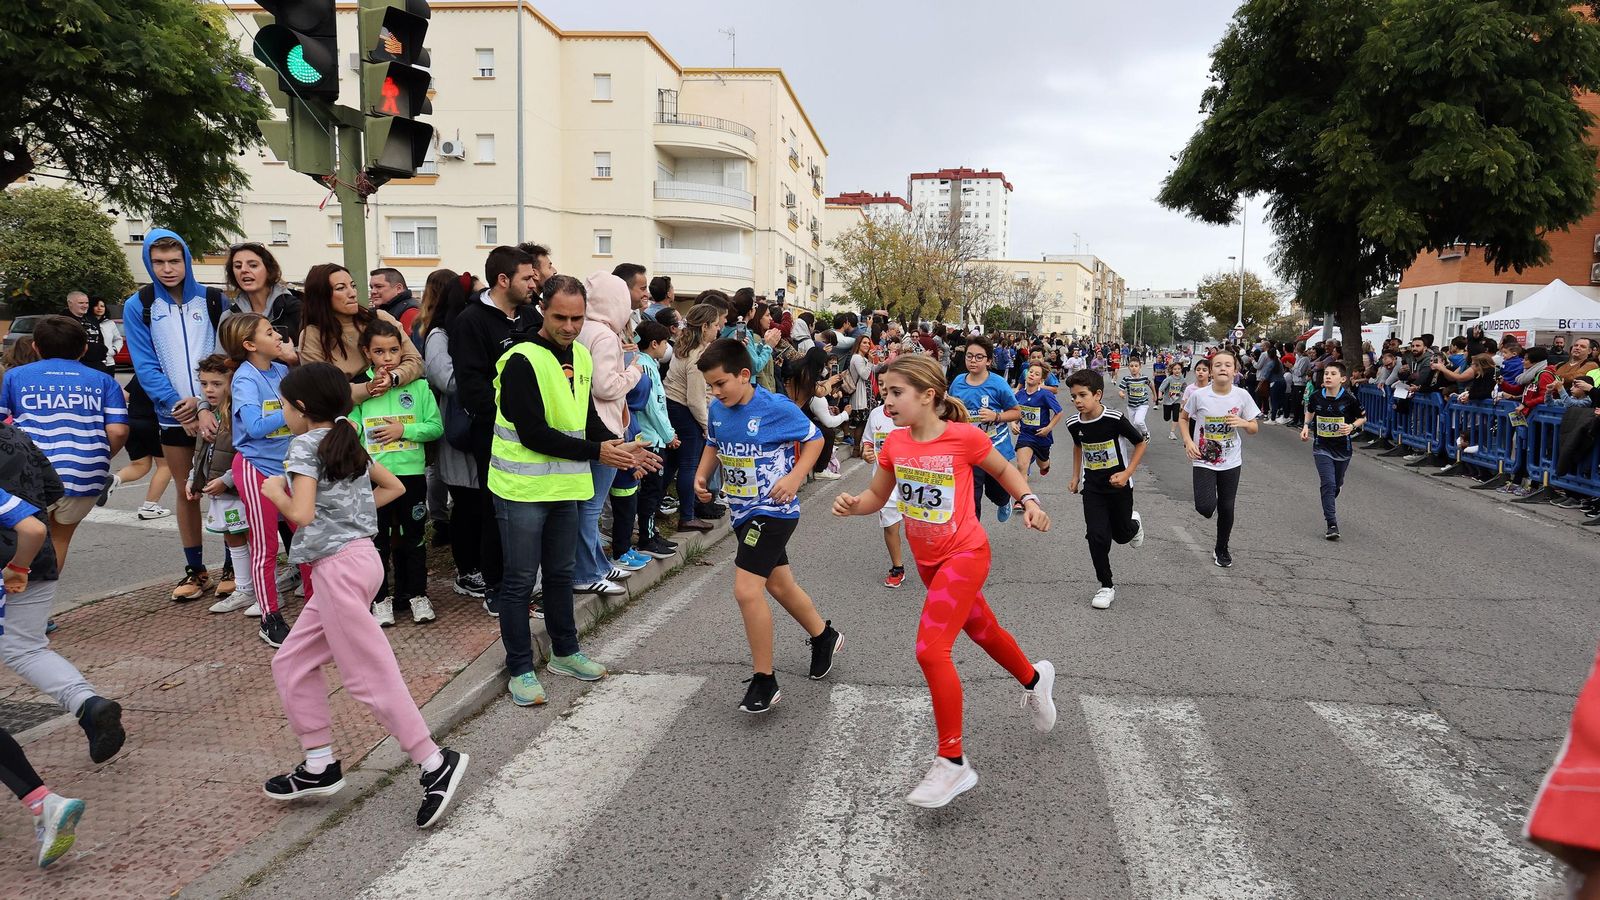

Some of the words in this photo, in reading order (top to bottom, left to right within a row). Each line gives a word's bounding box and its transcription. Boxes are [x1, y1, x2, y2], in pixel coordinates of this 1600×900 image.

[21, 385, 102, 394] ATLETISMO
[21, 393, 102, 411] CHAPIN
[1209, 423, 1232, 433] 320
[1320, 423, 1340, 431] 310
[1087, 450, 1109, 462] 251
[897, 466, 914, 475] CARRERA
[931, 472, 953, 480] BENEFICA
[929, 477, 943, 485] JEREZ
[901, 483, 942, 507] 913
